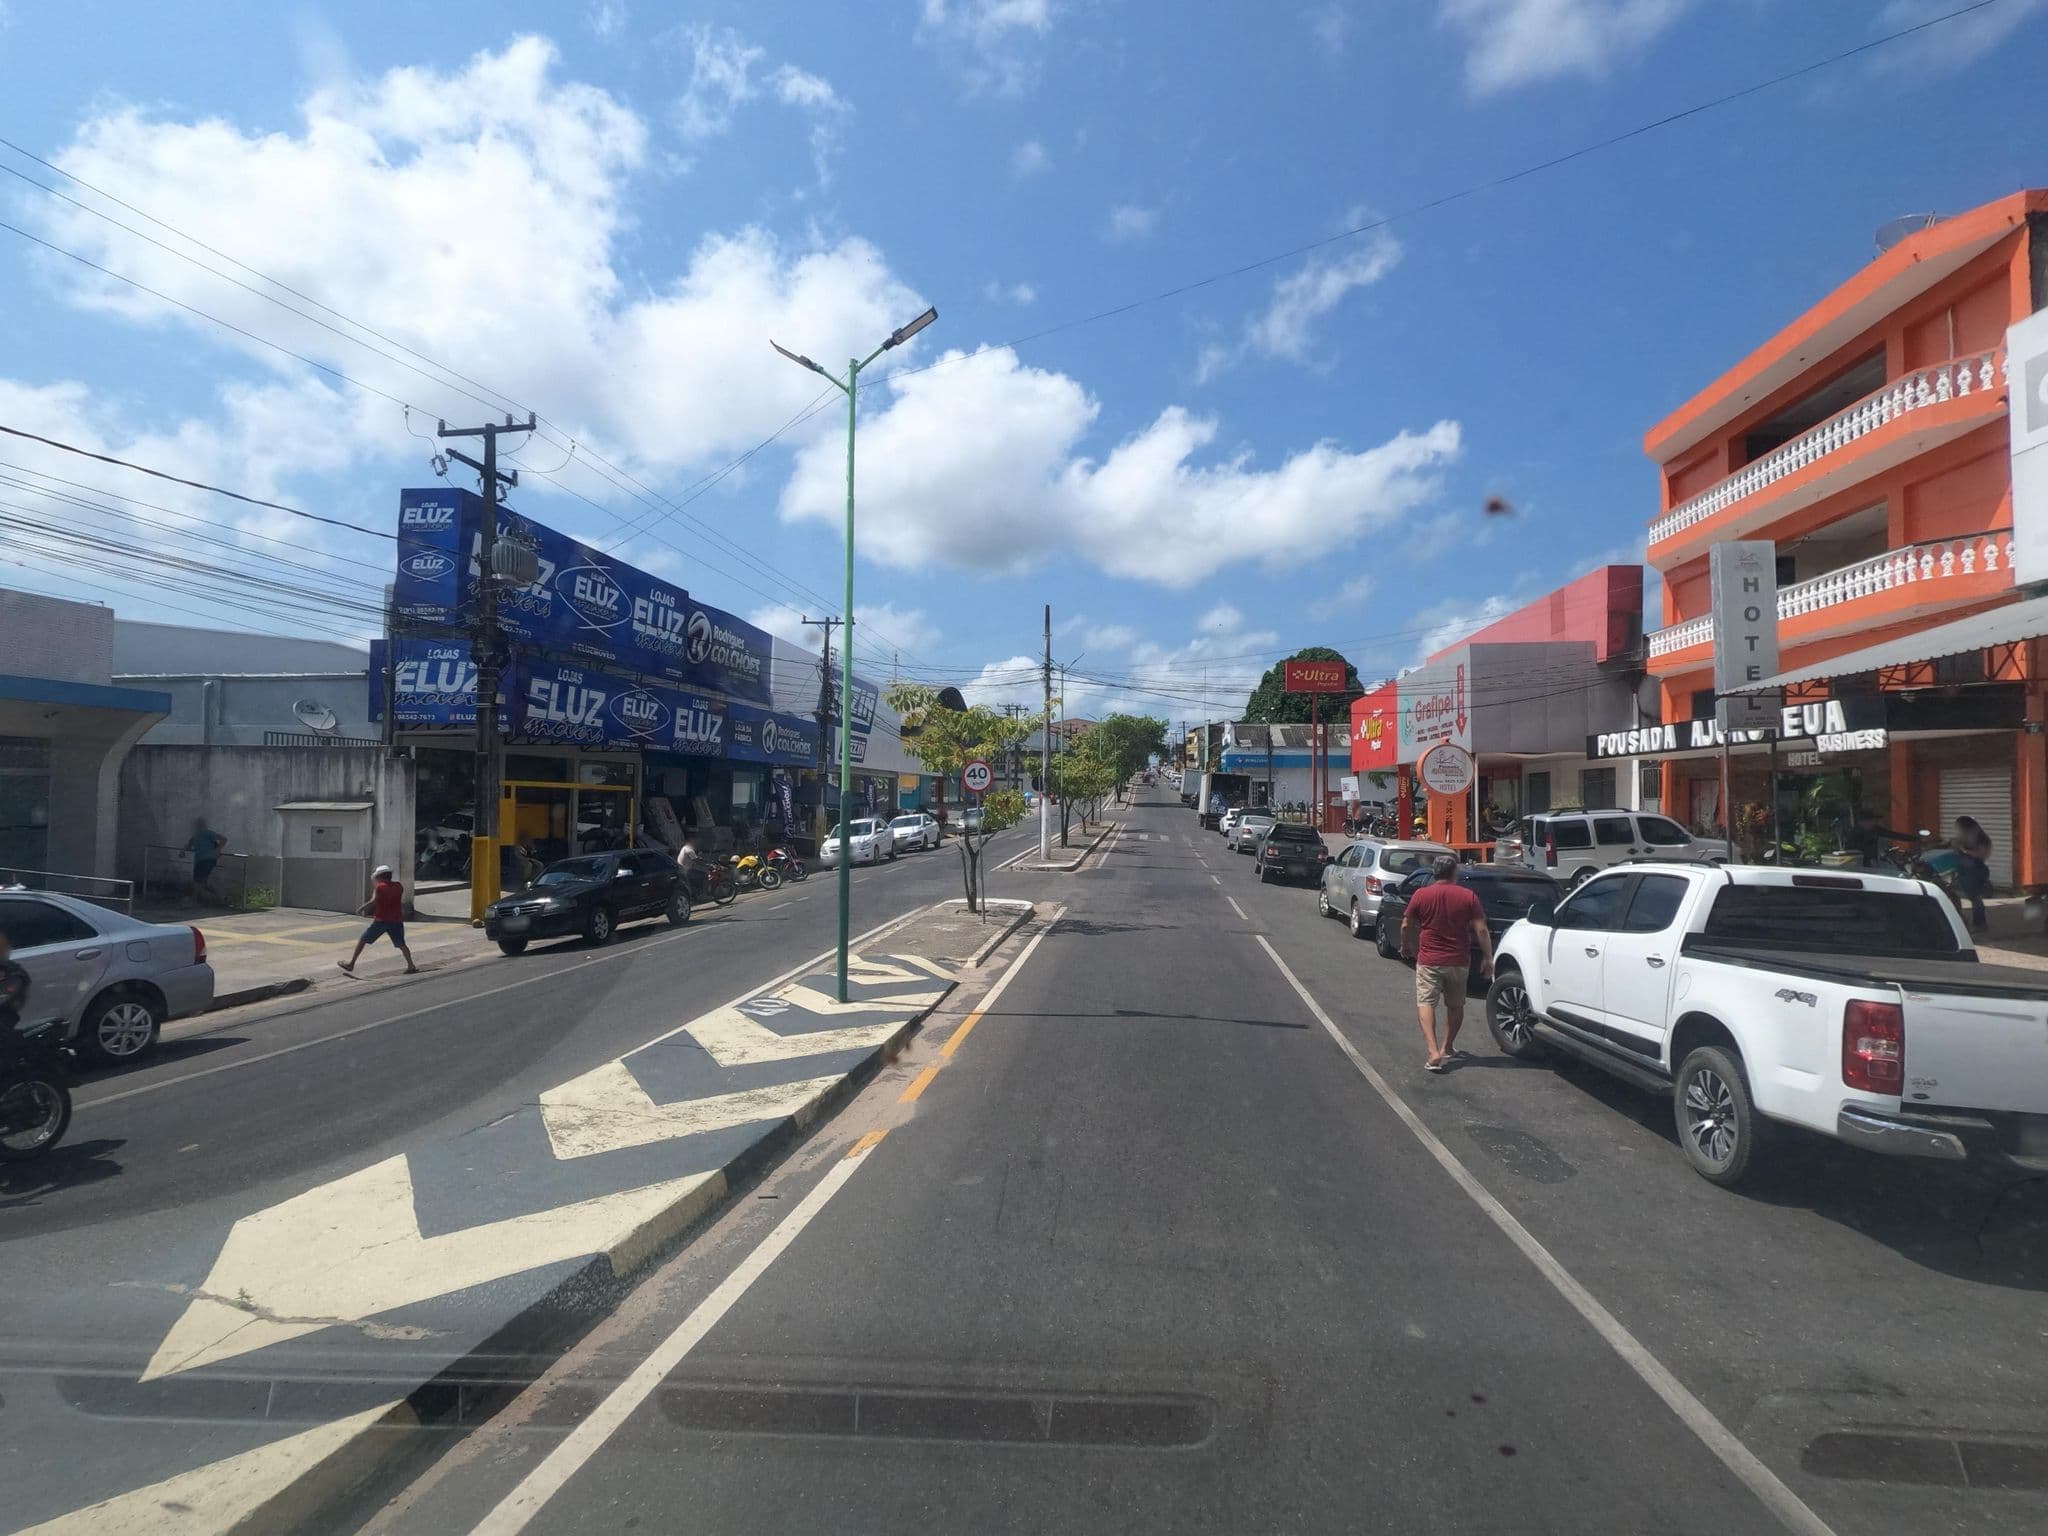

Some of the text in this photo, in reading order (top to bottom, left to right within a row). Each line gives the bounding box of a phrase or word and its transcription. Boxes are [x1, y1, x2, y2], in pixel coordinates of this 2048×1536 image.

[403, 507, 454, 524] ELUZ
[412, 559, 443, 570] ELUZ
[574, 575, 619, 611] ELUZ
[650, 588, 675, 608] LOJAS
[632, 596, 685, 645] ELUZ
[713, 625, 745, 650] Rodrigues
[1743, 577, 1762, 711] HOTEL
[427, 649, 460, 660] LOJAS
[395, 661, 478, 693] ELUZ
[557, 667, 583, 685] LOJAS
[1304, 669, 1339, 681] Ultra
[527, 678, 606, 727] ELUZ
[622, 697, 659, 721] ELUZ
[674, 707, 723, 744] ELUZ
[1366, 718, 1382, 740] Ultra
[1597, 700, 1847, 757] POUSADA AJUEUA
[1817, 728, 1888, 753] BUSINESS
[1788, 752, 1823, 767] HOTEL
[966, 767, 987, 779] 40
[1775, 988, 1818, 1007] 4x4
